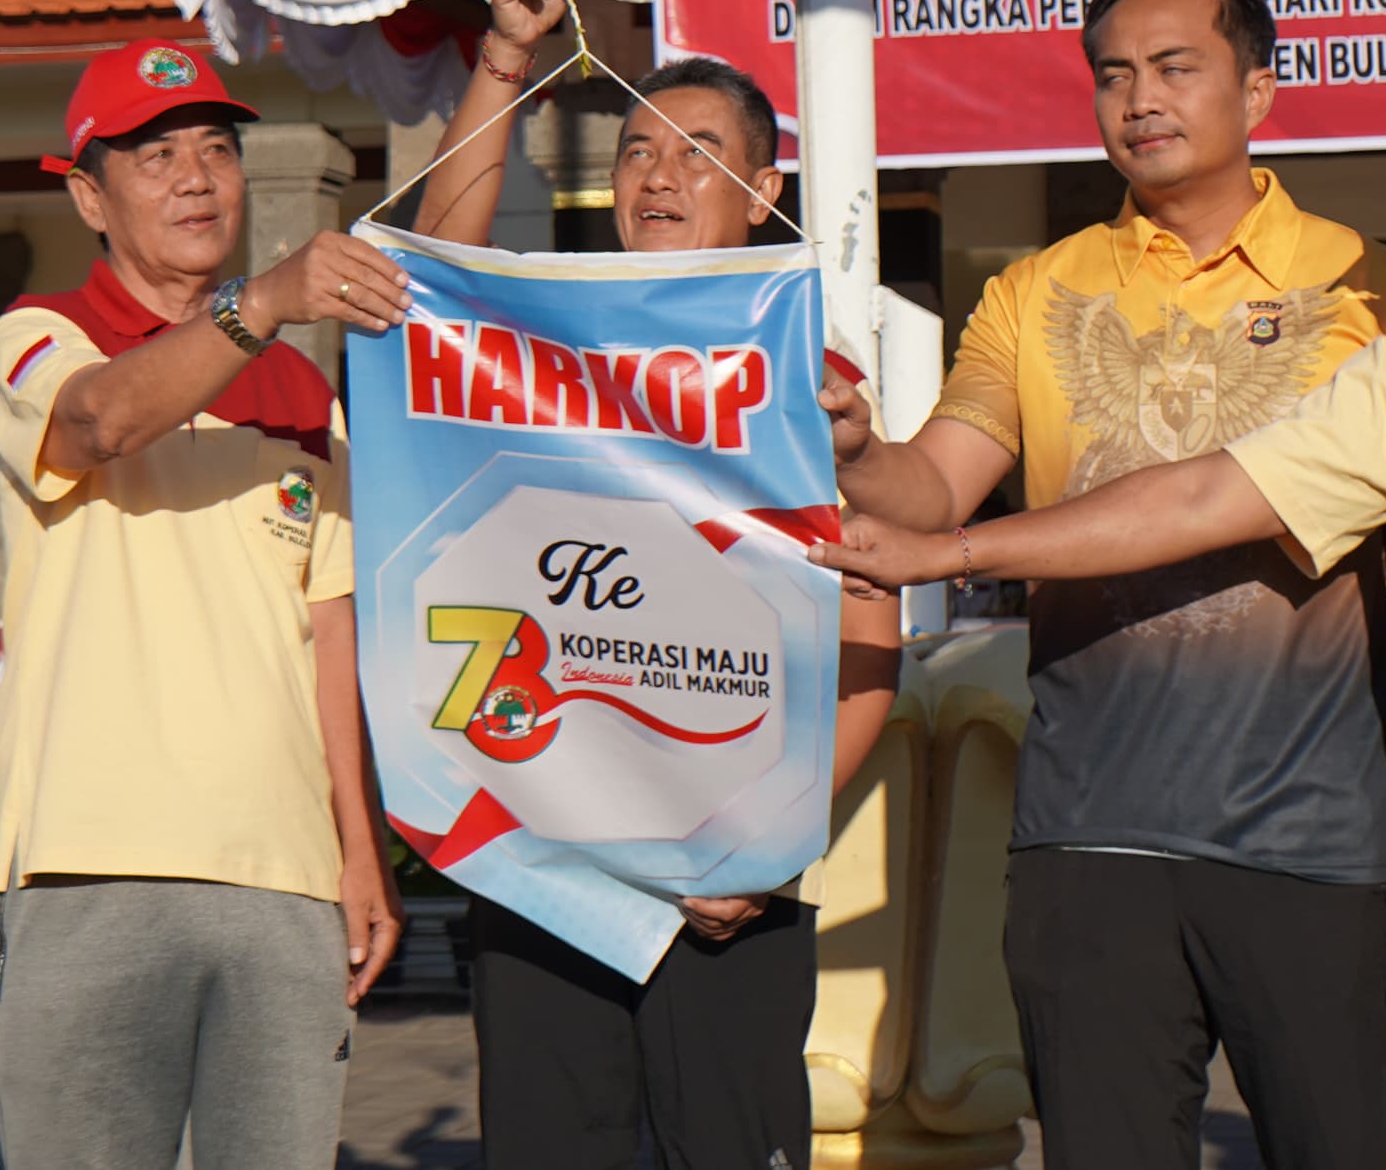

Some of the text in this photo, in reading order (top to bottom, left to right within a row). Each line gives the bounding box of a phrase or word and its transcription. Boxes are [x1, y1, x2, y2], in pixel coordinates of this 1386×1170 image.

[406, 319, 770, 452] HARKOP
[538, 540, 645, 611] Ke
[428, 605, 562, 763] 78
[560, 661, 770, 699] Indonesia ADIL MAKMUR
[561, 633, 769, 677] KOPERASI MAJU
